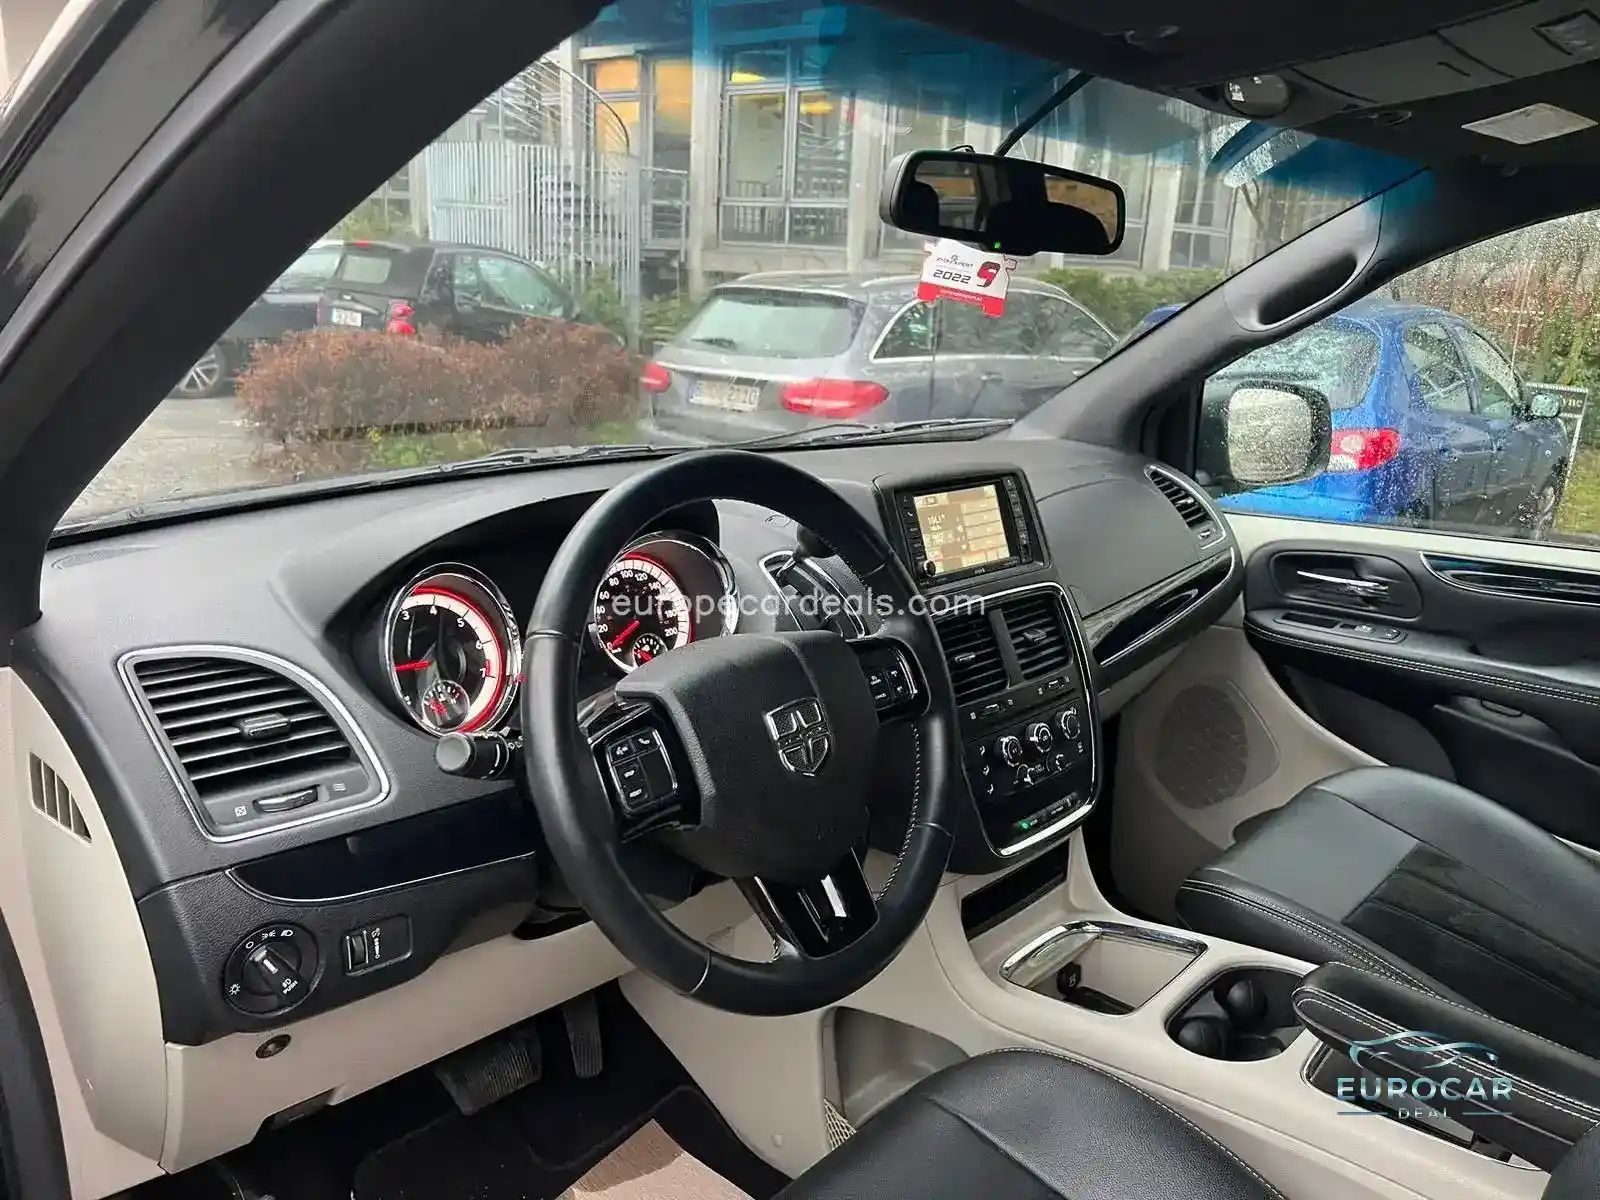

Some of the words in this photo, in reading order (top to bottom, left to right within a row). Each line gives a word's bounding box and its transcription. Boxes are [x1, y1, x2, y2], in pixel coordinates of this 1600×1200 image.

[933, 269, 971, 284] 2022
[620, 570, 633, 579] 100
[635, 572, 648, 581] 120
[609, 578, 619, 586] 80
[600, 591, 609, 599] 60
[430, 606, 438, 615] 4
[402, 611, 410, 620] 3
[457, 618, 465, 628] 5
[597, 624, 609, 633] 20
[664, 627, 678, 637] 200
[475, 640, 484, 650] 6
[479, 668, 486, 678] 7
